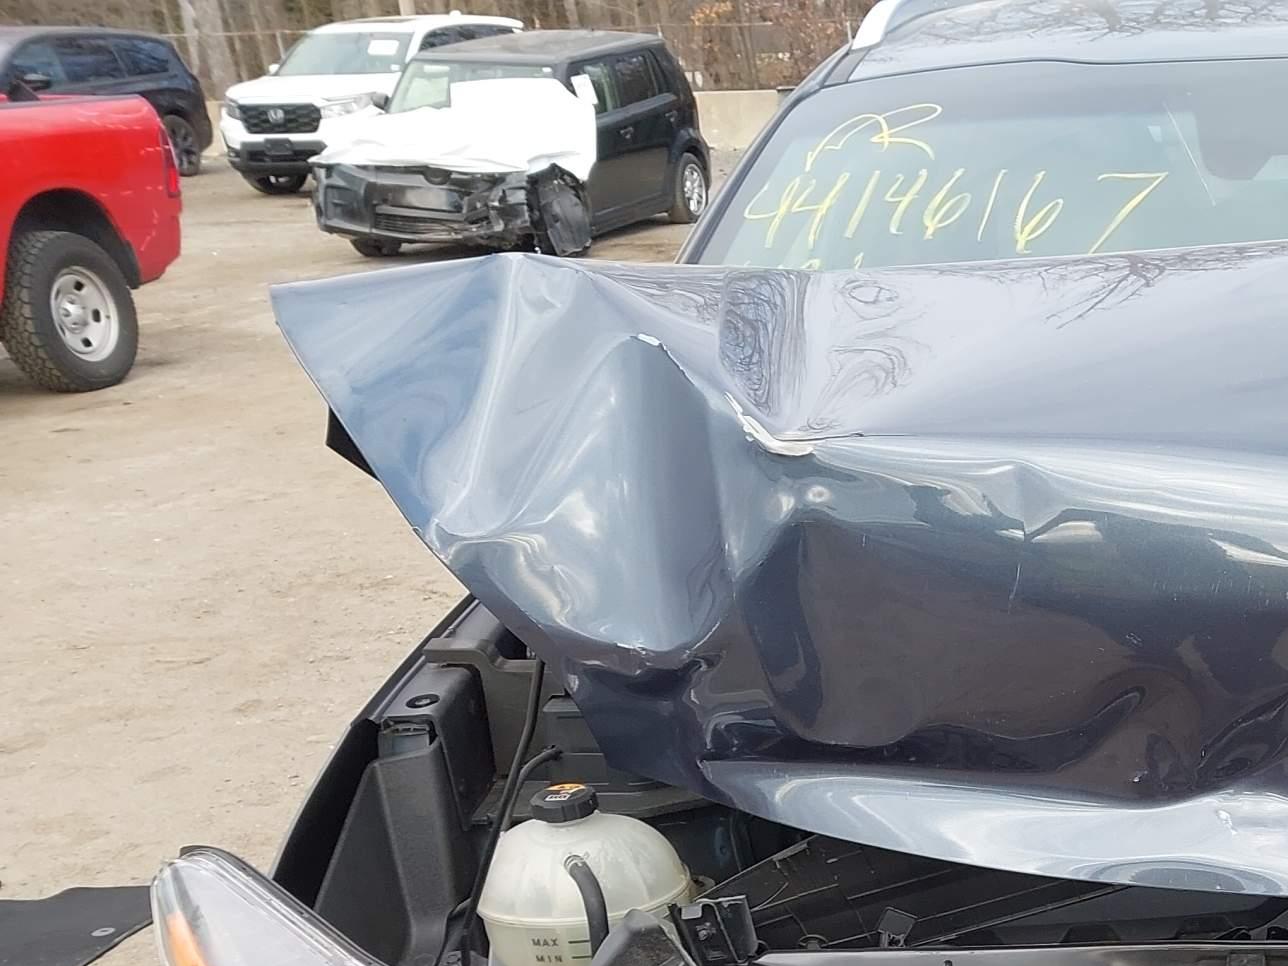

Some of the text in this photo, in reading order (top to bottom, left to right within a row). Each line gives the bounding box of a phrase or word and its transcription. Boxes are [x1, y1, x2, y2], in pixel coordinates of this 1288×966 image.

[743, 167, 1170, 254] 44146167
[531, 938, 559, 948] MAX
[536, 954, 563, 964] MIN
